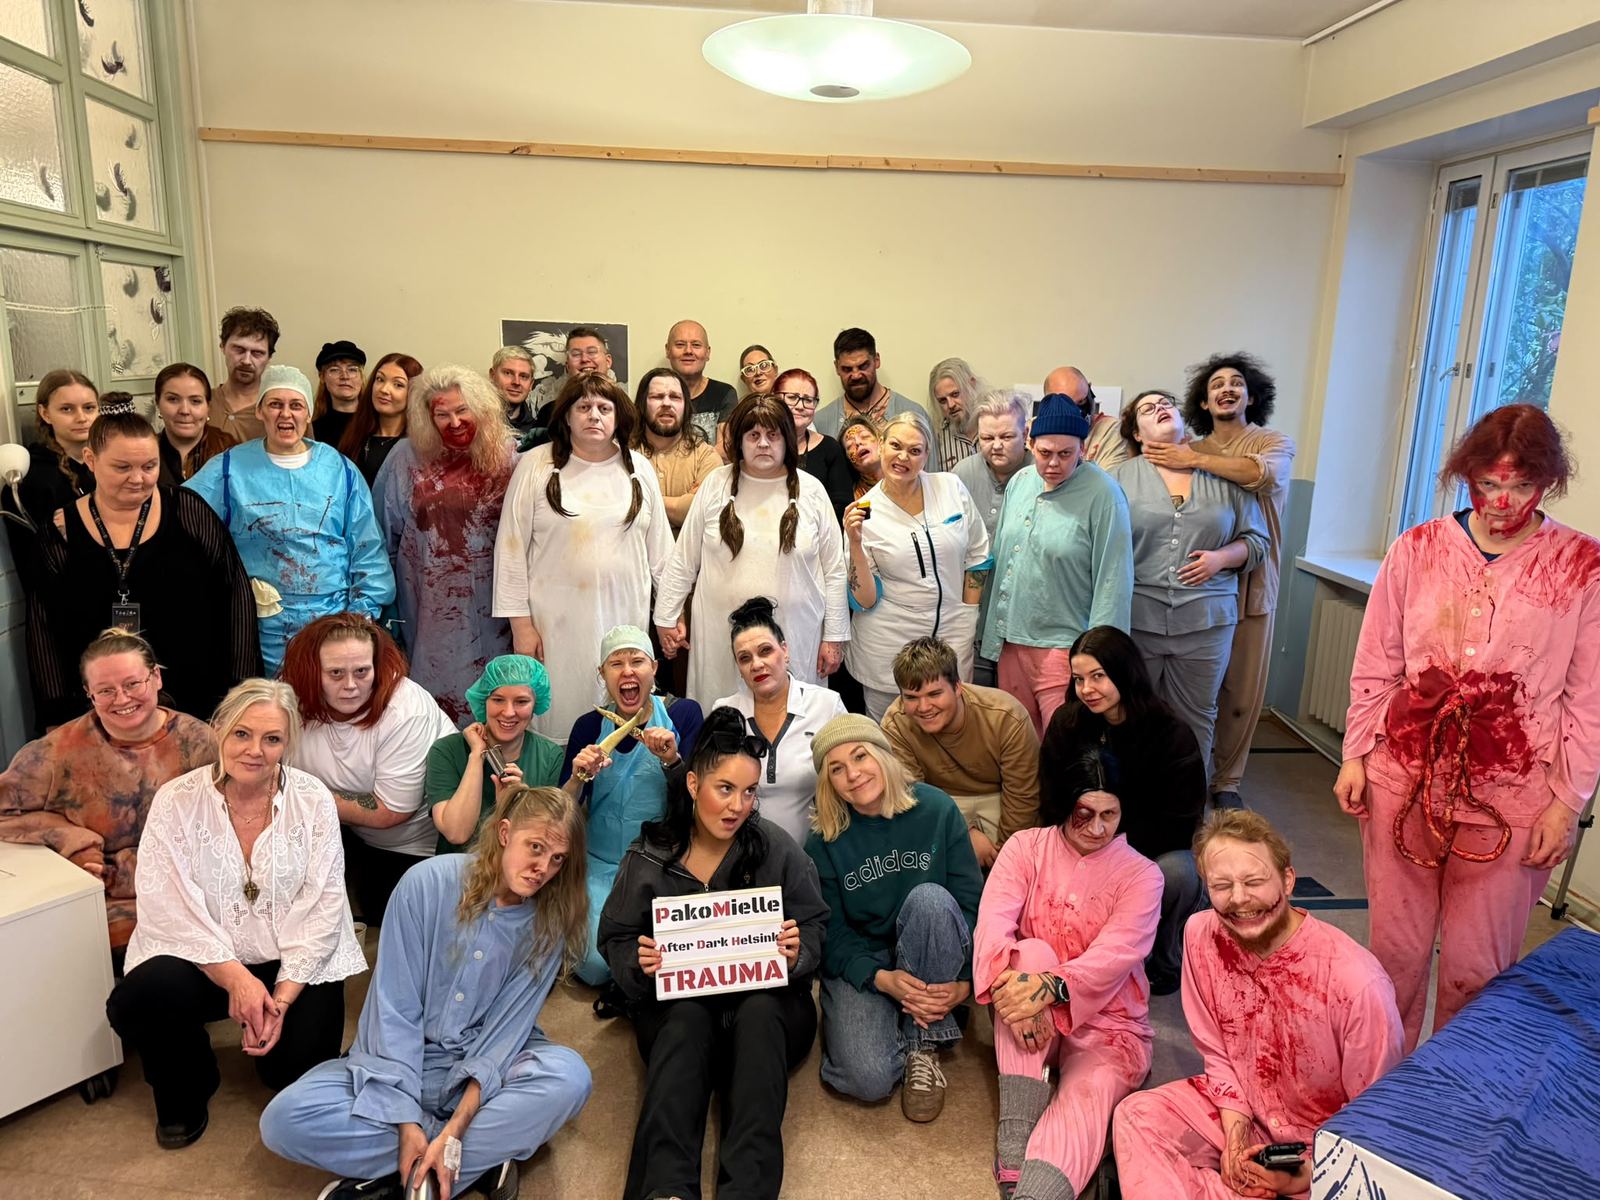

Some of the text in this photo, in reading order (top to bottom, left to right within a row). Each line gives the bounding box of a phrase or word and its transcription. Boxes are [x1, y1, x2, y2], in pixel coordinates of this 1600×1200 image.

[844, 849, 931, 891] adidas
[655, 896, 780, 924] PakoMielle
[660, 931, 782, 953] After Dark Helsink
[658, 959, 784, 993] TRAUMA
